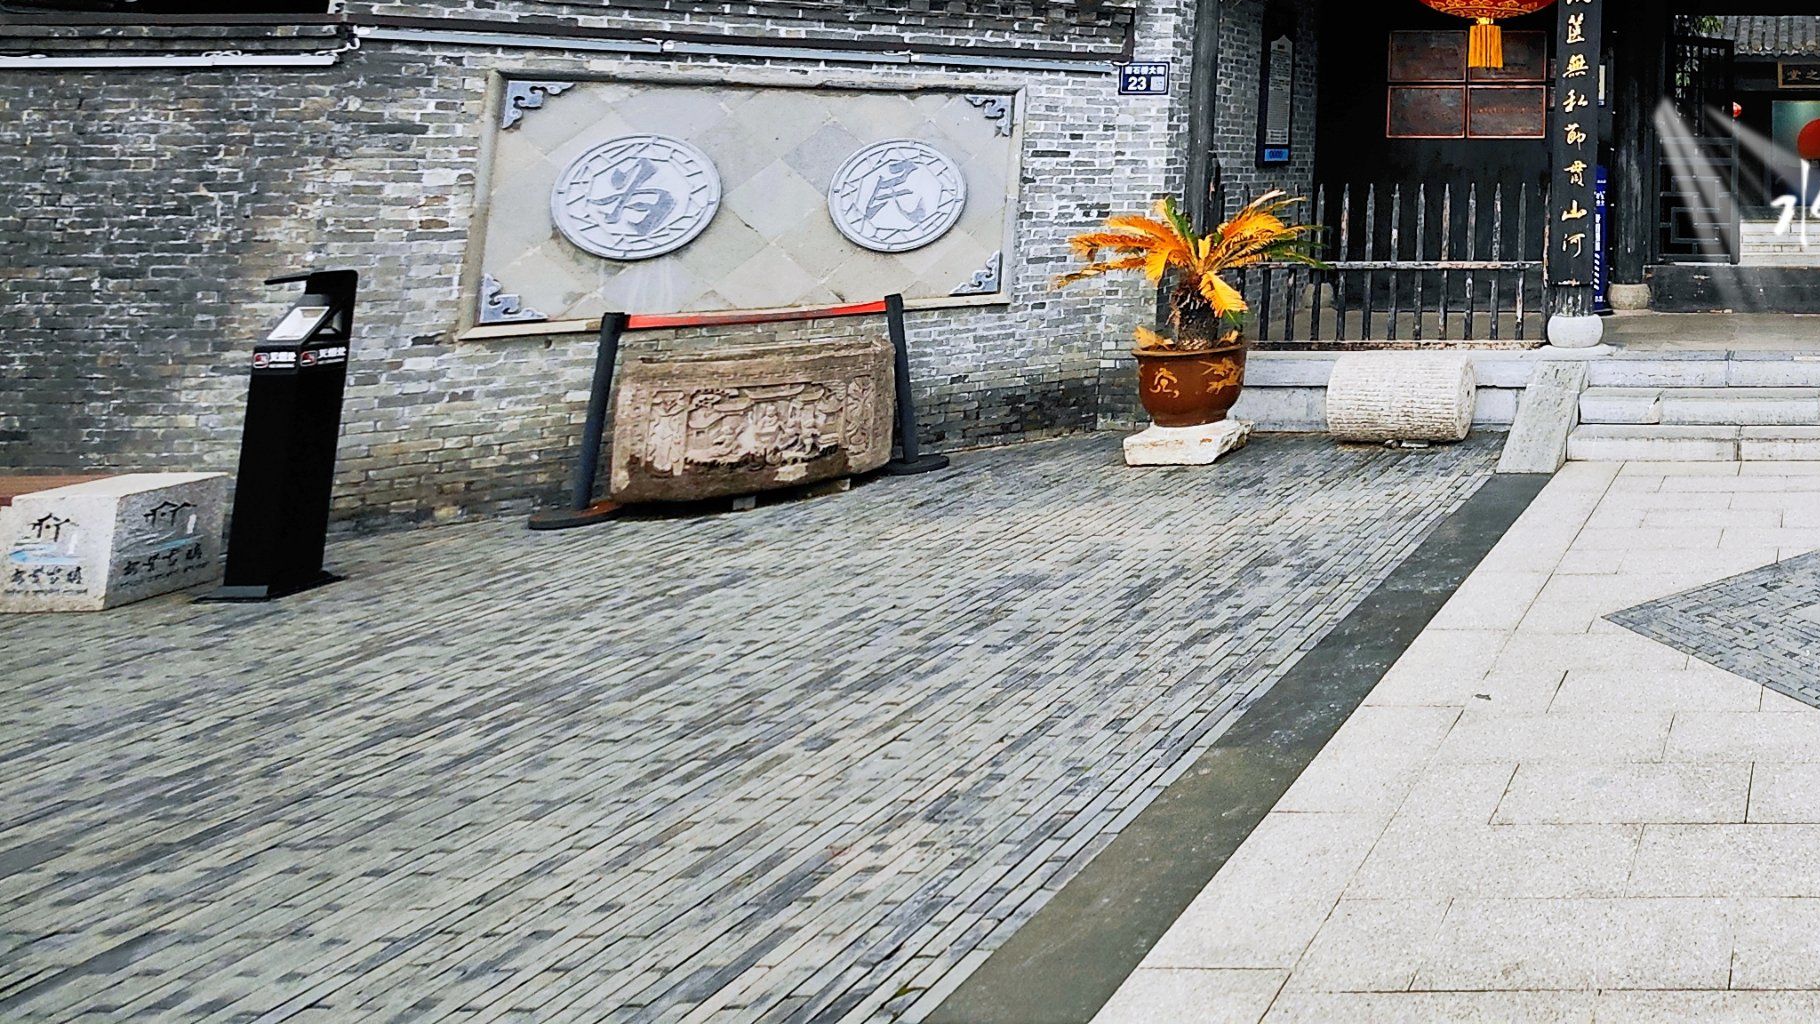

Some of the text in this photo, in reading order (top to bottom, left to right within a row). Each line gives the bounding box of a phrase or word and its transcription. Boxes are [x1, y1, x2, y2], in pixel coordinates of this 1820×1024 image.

[1127, 76, 1147, 91] 23
[587, 156, 676, 236] 为
[863, 159, 928, 223] 民
